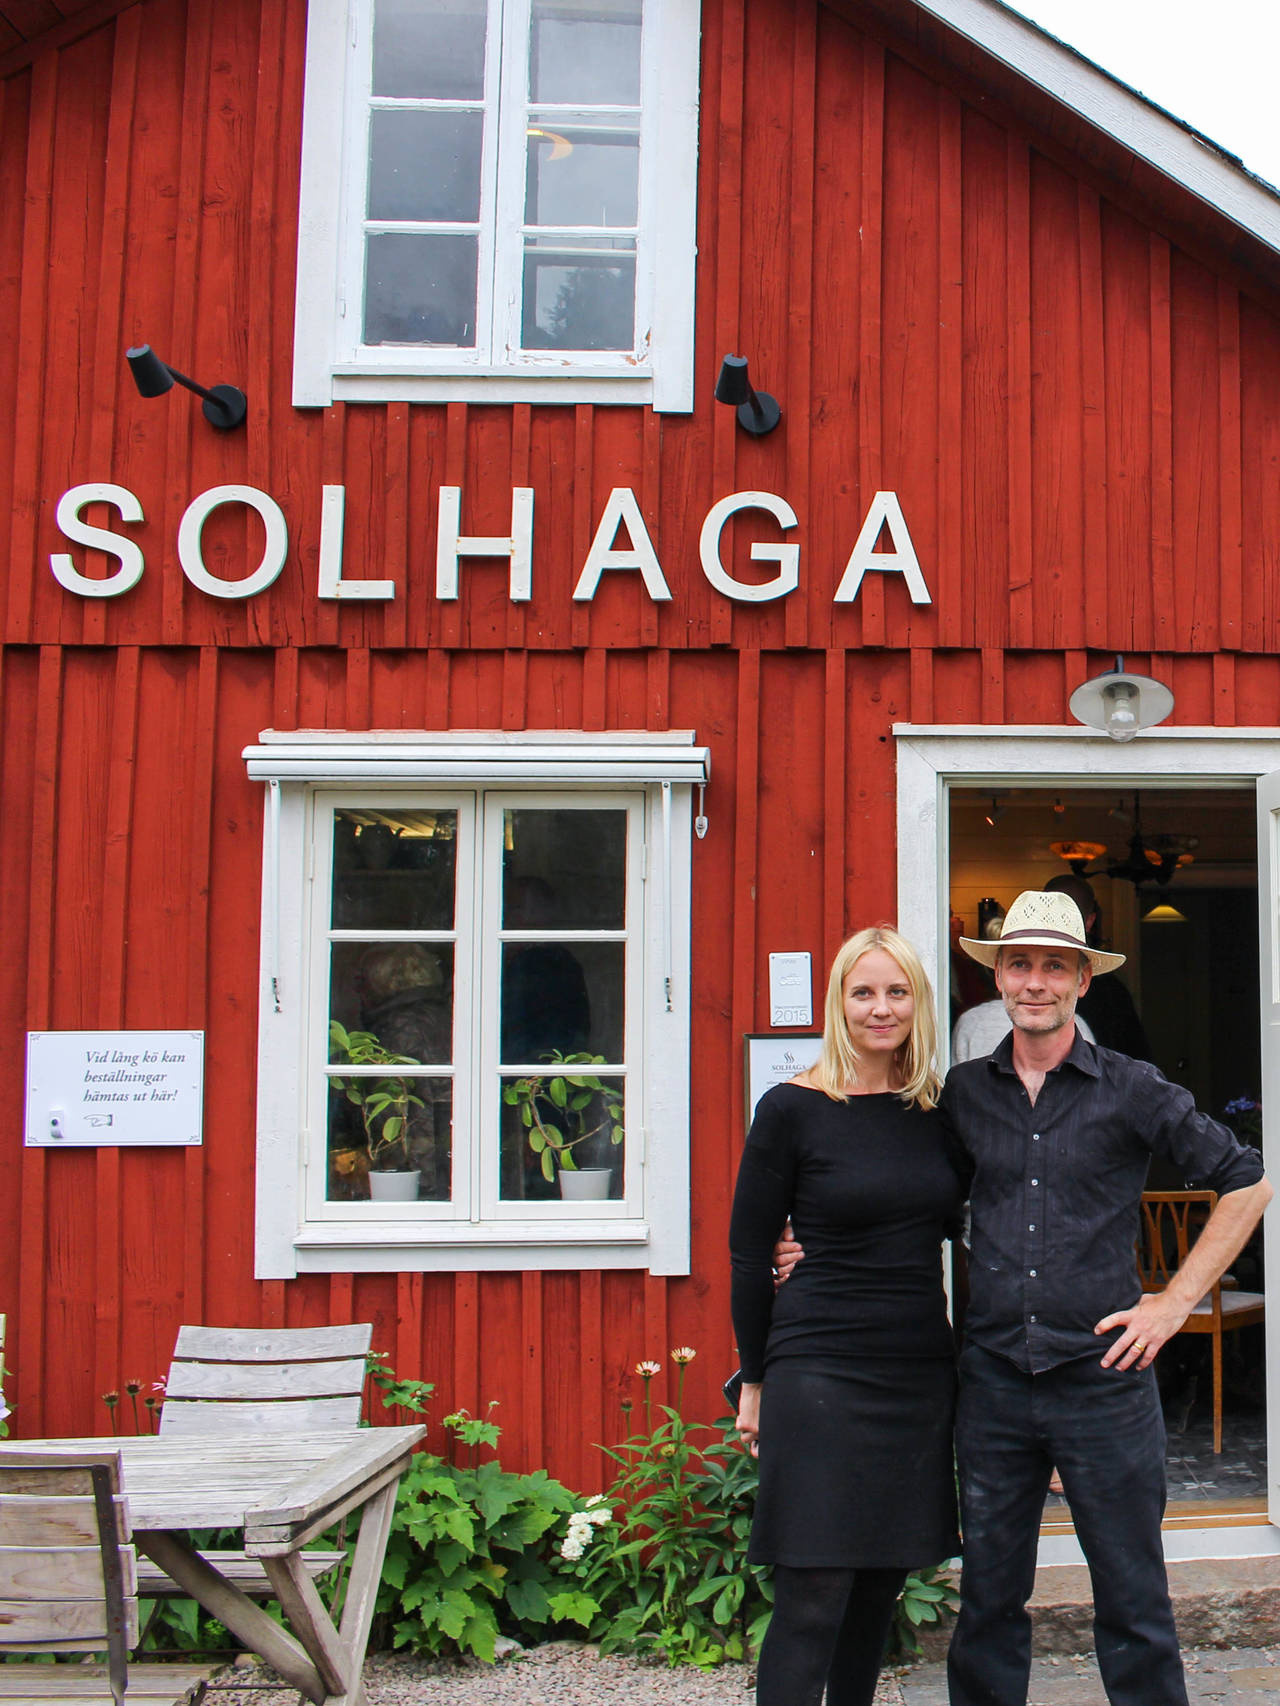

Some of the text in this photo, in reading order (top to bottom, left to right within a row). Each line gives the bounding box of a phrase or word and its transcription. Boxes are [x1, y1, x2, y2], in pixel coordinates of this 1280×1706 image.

[48, 483, 933, 605] SOLHAGA
[775, 1009, 809, 1023] 2015
[86, 1050, 186, 1067] Vid lång kö kan
[84, 1070, 167, 1086] beställningar
[83, 1089, 178, 1102] hämtas ut här!
